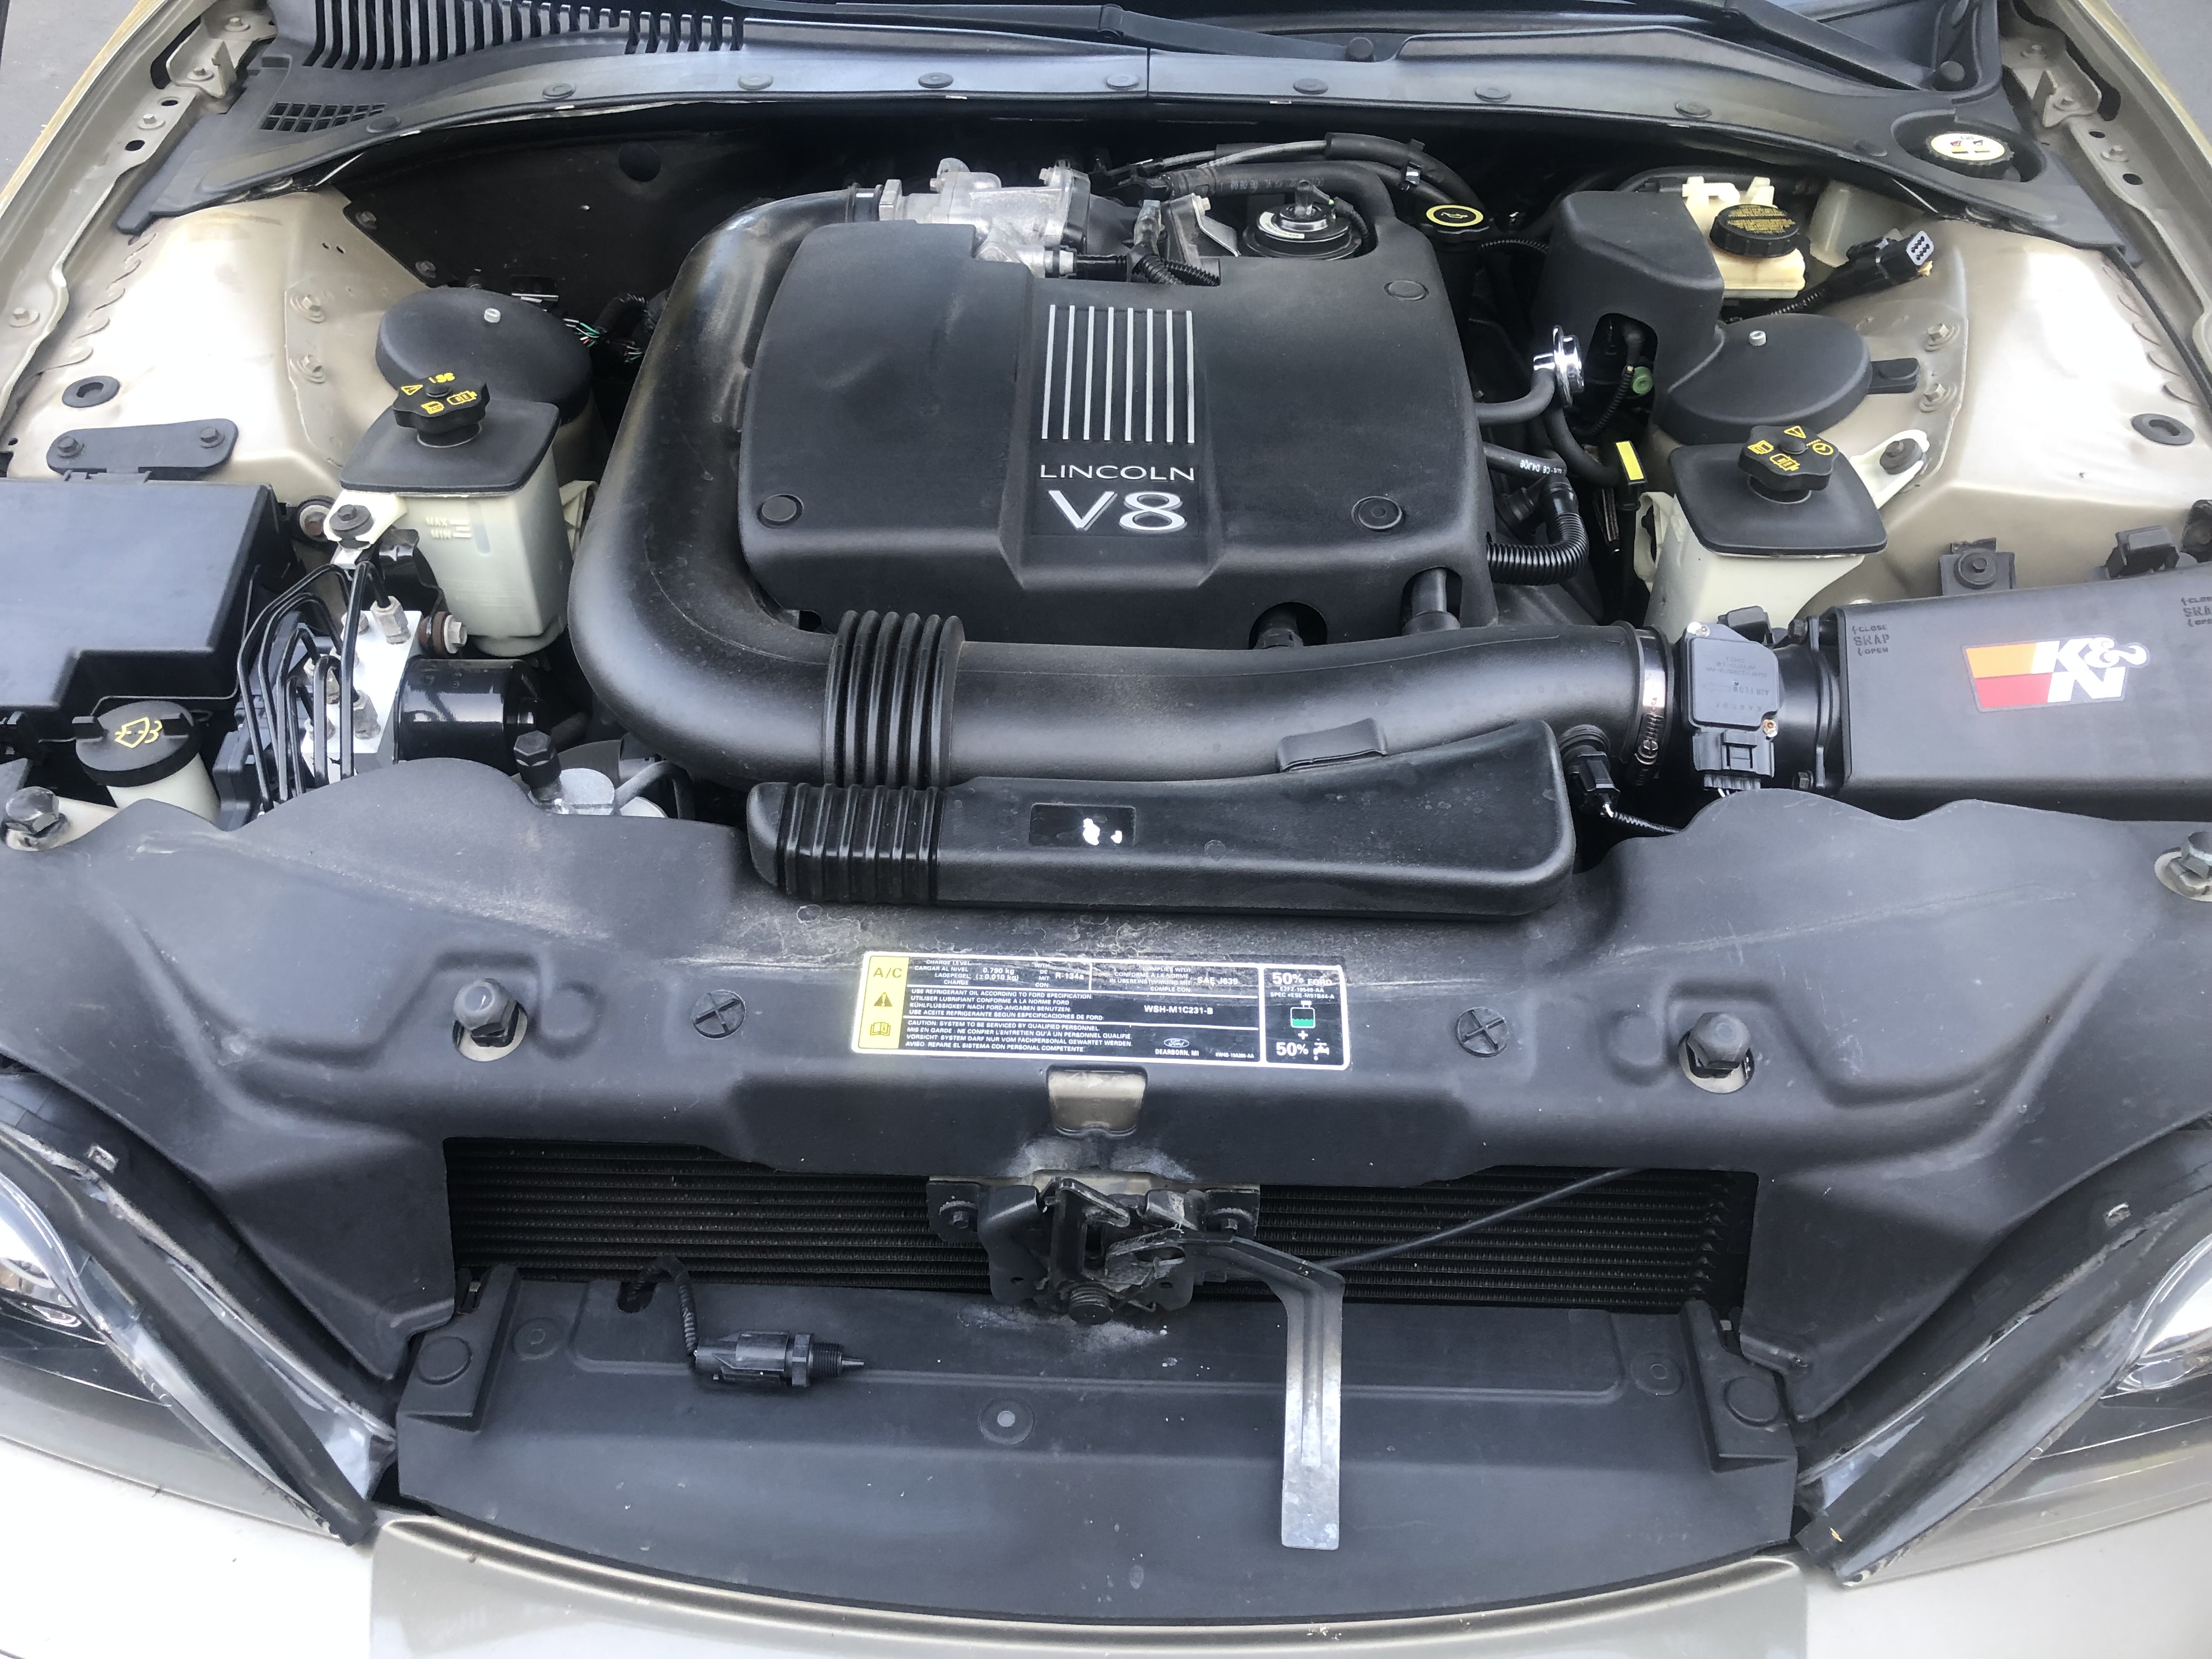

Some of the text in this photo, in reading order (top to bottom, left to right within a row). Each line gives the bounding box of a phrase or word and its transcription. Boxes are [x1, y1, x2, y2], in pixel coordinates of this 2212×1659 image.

[1040, 464, 1195, 481] LINCOLN
[1048, 490, 1187, 532] V8
[426, 516, 447, 526] MAX
[431, 529, 451, 539] MIN
[873, 967, 902, 979] A/C
[1272, 972, 1304, 985] 50%
[1144, 1005, 1214, 1014] WSH-M1C231-B
[1155, 1048, 1189, 1056] DEARBORN,
[1276, 1042, 1308, 1056] 50%
